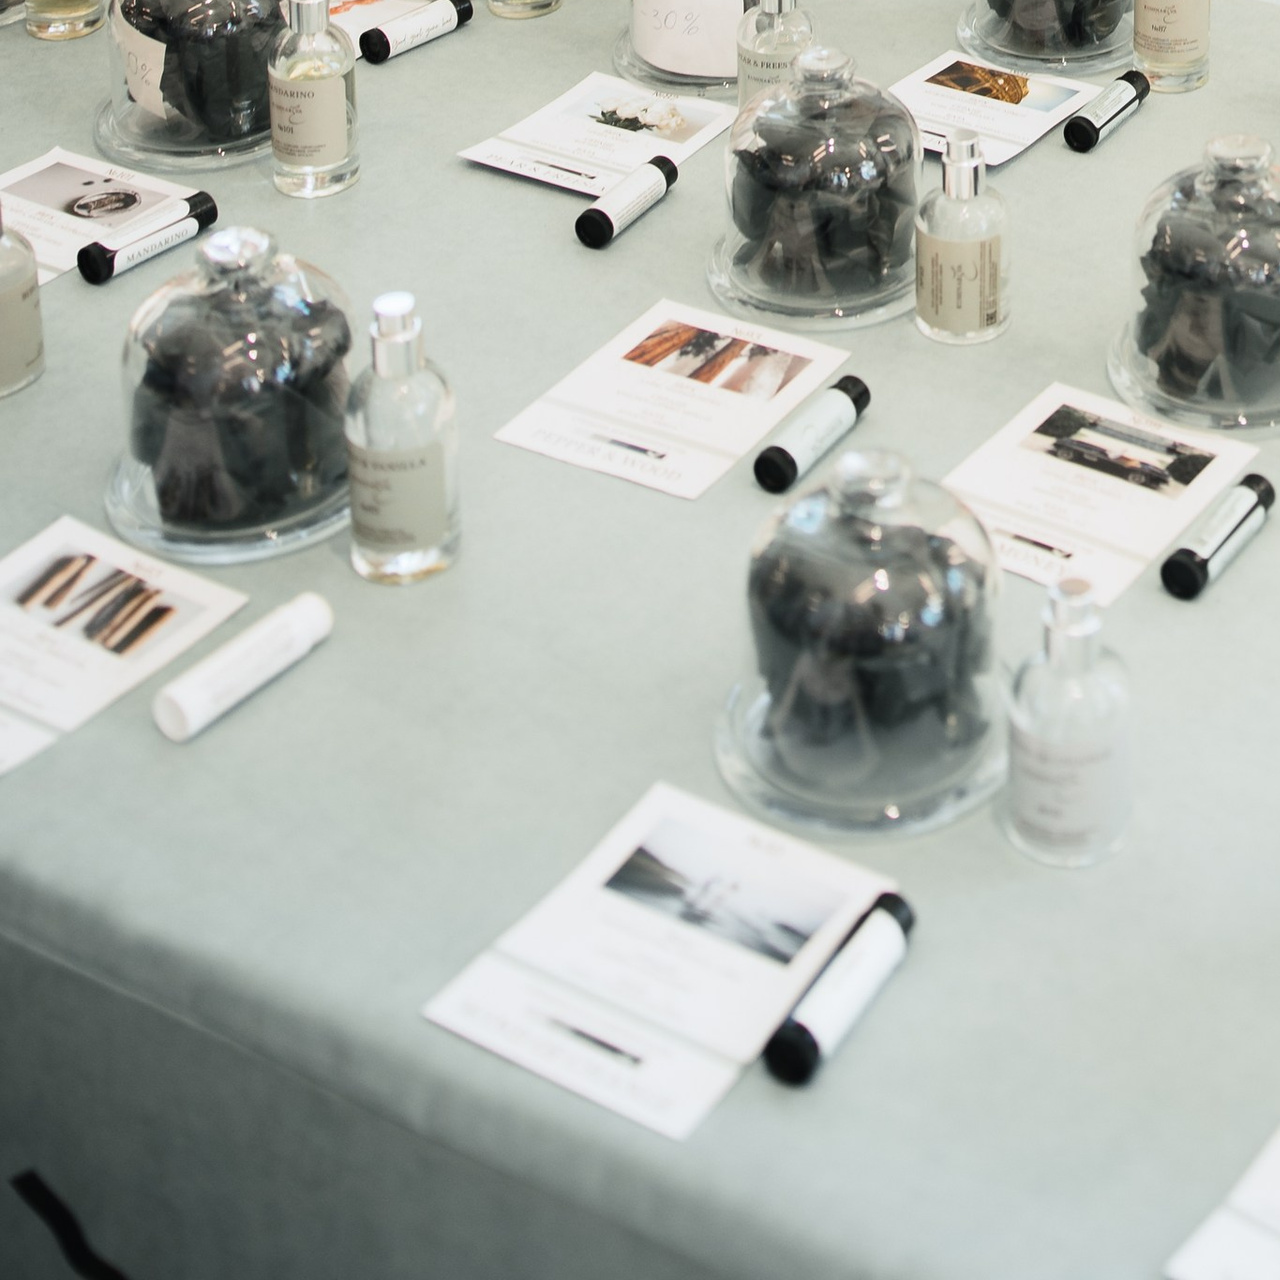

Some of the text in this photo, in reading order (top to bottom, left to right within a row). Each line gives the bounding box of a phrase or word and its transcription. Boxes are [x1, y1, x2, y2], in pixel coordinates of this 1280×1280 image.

[125, 227, 190, 265] MANDARINO
[531, 427, 602, 458] PEPPER
[622, 456, 683, 482] WOOD
